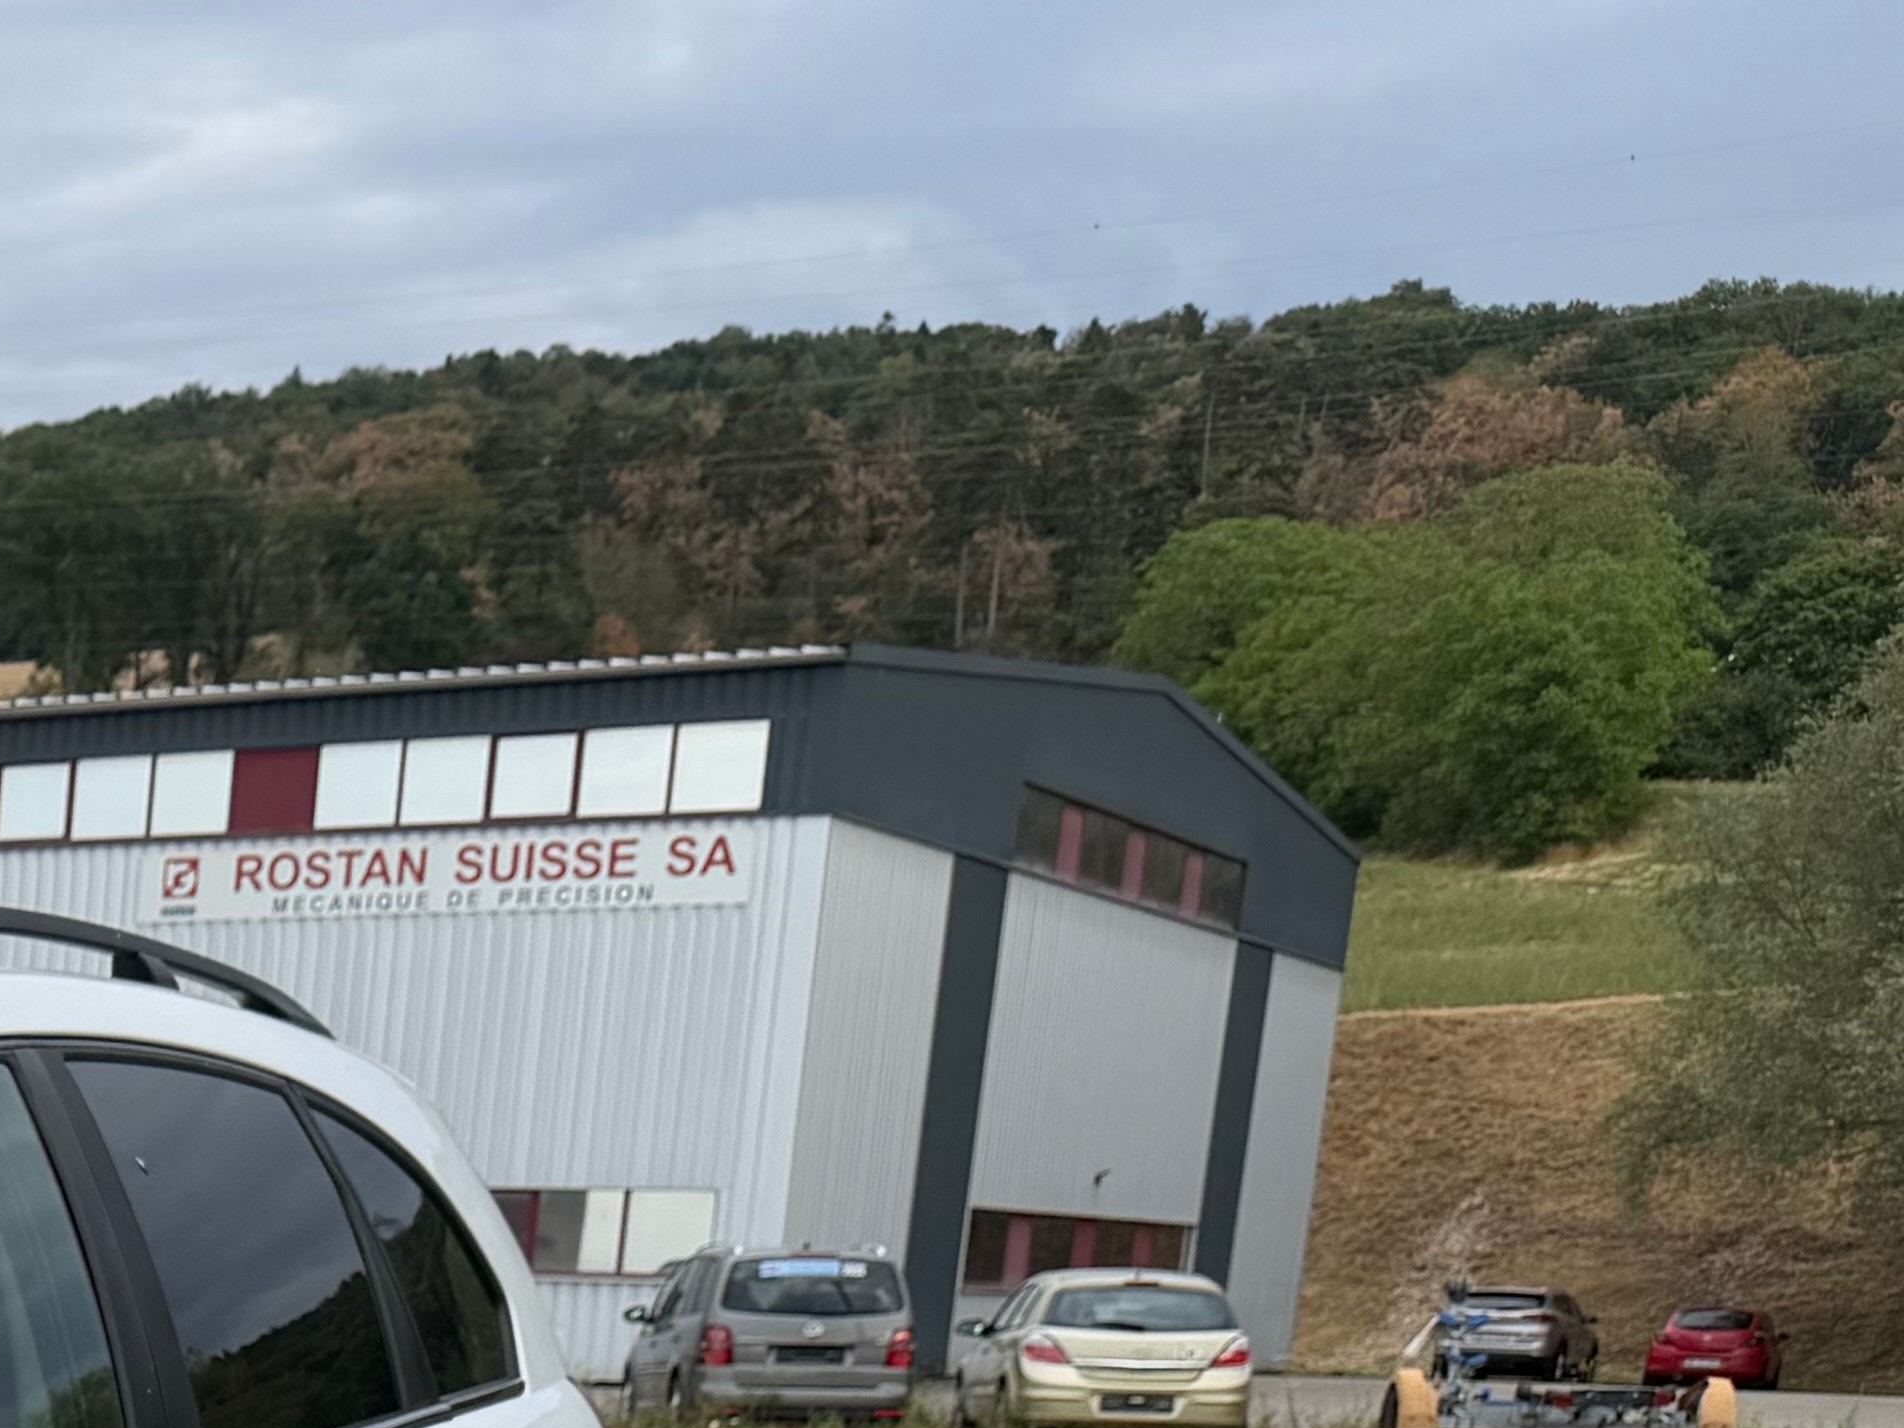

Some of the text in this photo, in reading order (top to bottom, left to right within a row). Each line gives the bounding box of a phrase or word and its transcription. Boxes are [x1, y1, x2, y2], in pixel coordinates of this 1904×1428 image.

[234, 834, 737, 893] ROSTAN SUISSE SA
[446, 885, 481, 908] DE
[497, 883, 655, 906] PRECISION
